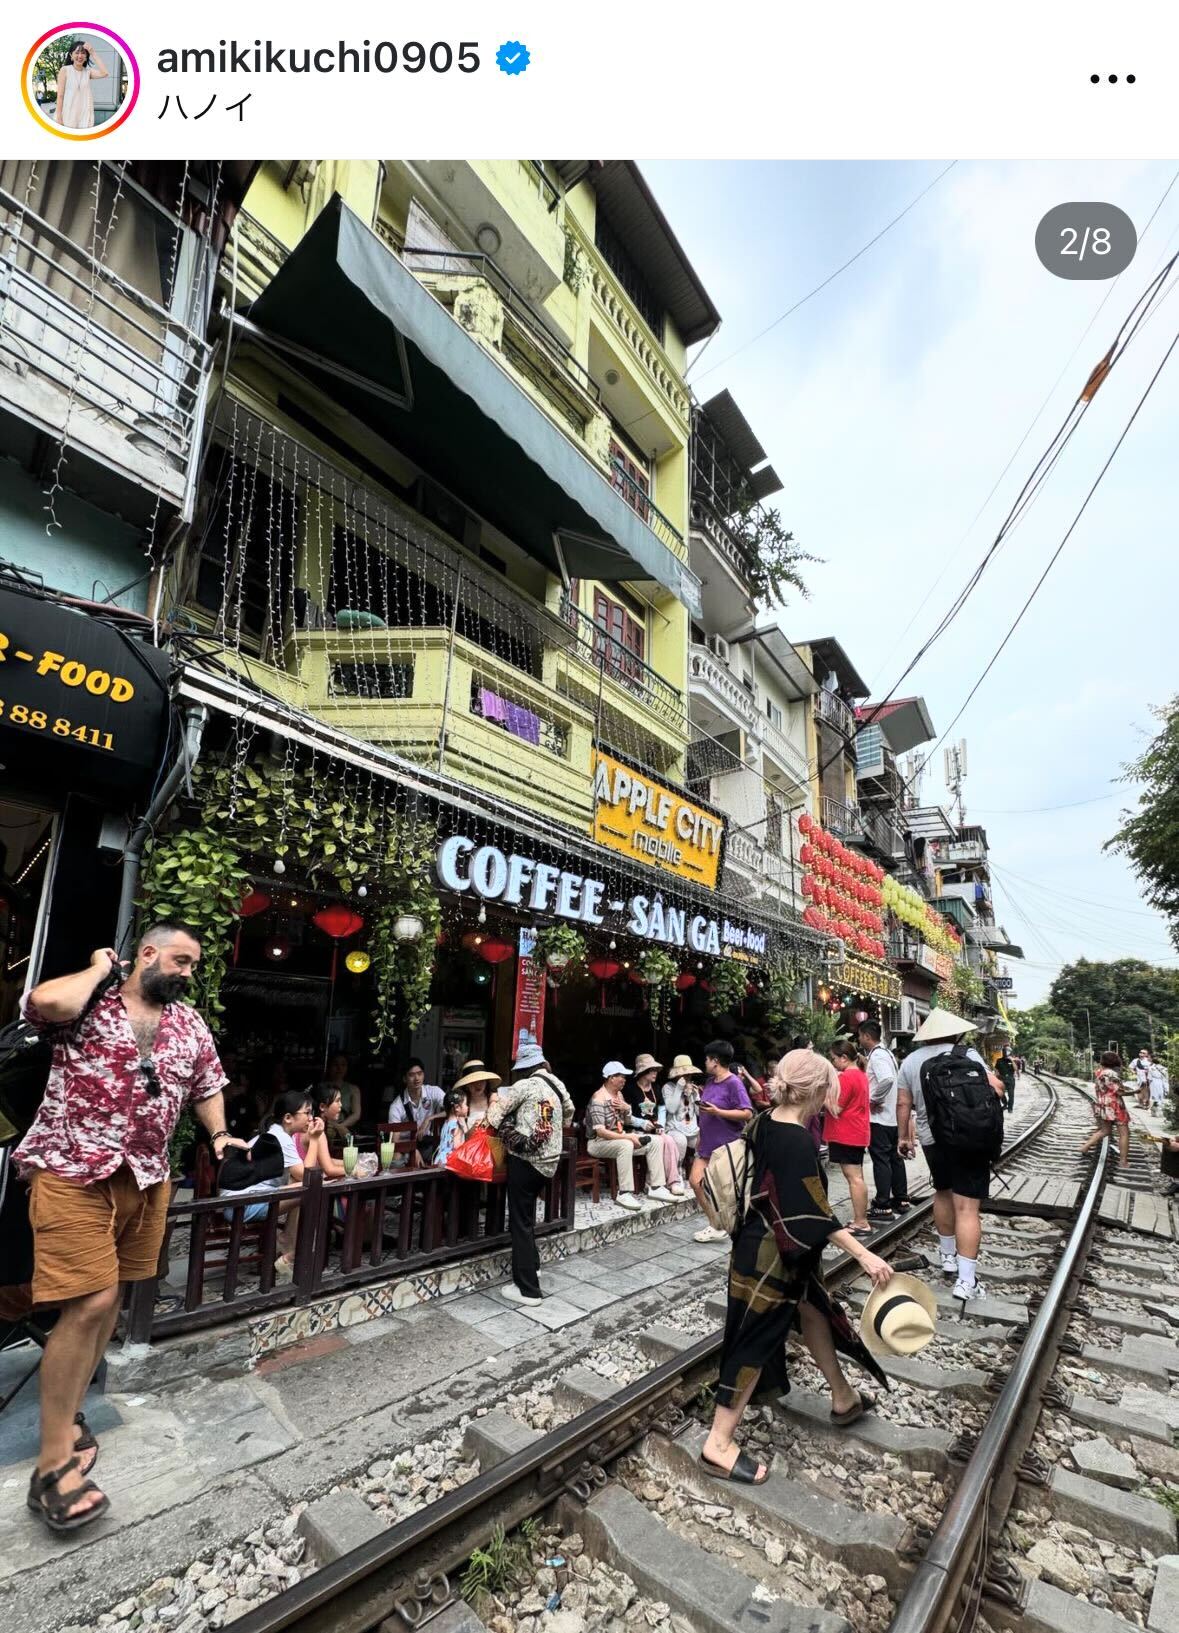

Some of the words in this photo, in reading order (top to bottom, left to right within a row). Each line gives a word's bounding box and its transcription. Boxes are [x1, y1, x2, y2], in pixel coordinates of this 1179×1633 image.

[36, 650, 135, 702] FOOD
[596, 759, 675, 830] APPLE
[675, 806, 725, 854] CITY
[437, 835, 605, 925] COFFEE
[627, 892, 686, 947] SÂN
[688, 915, 721, 956] GA
